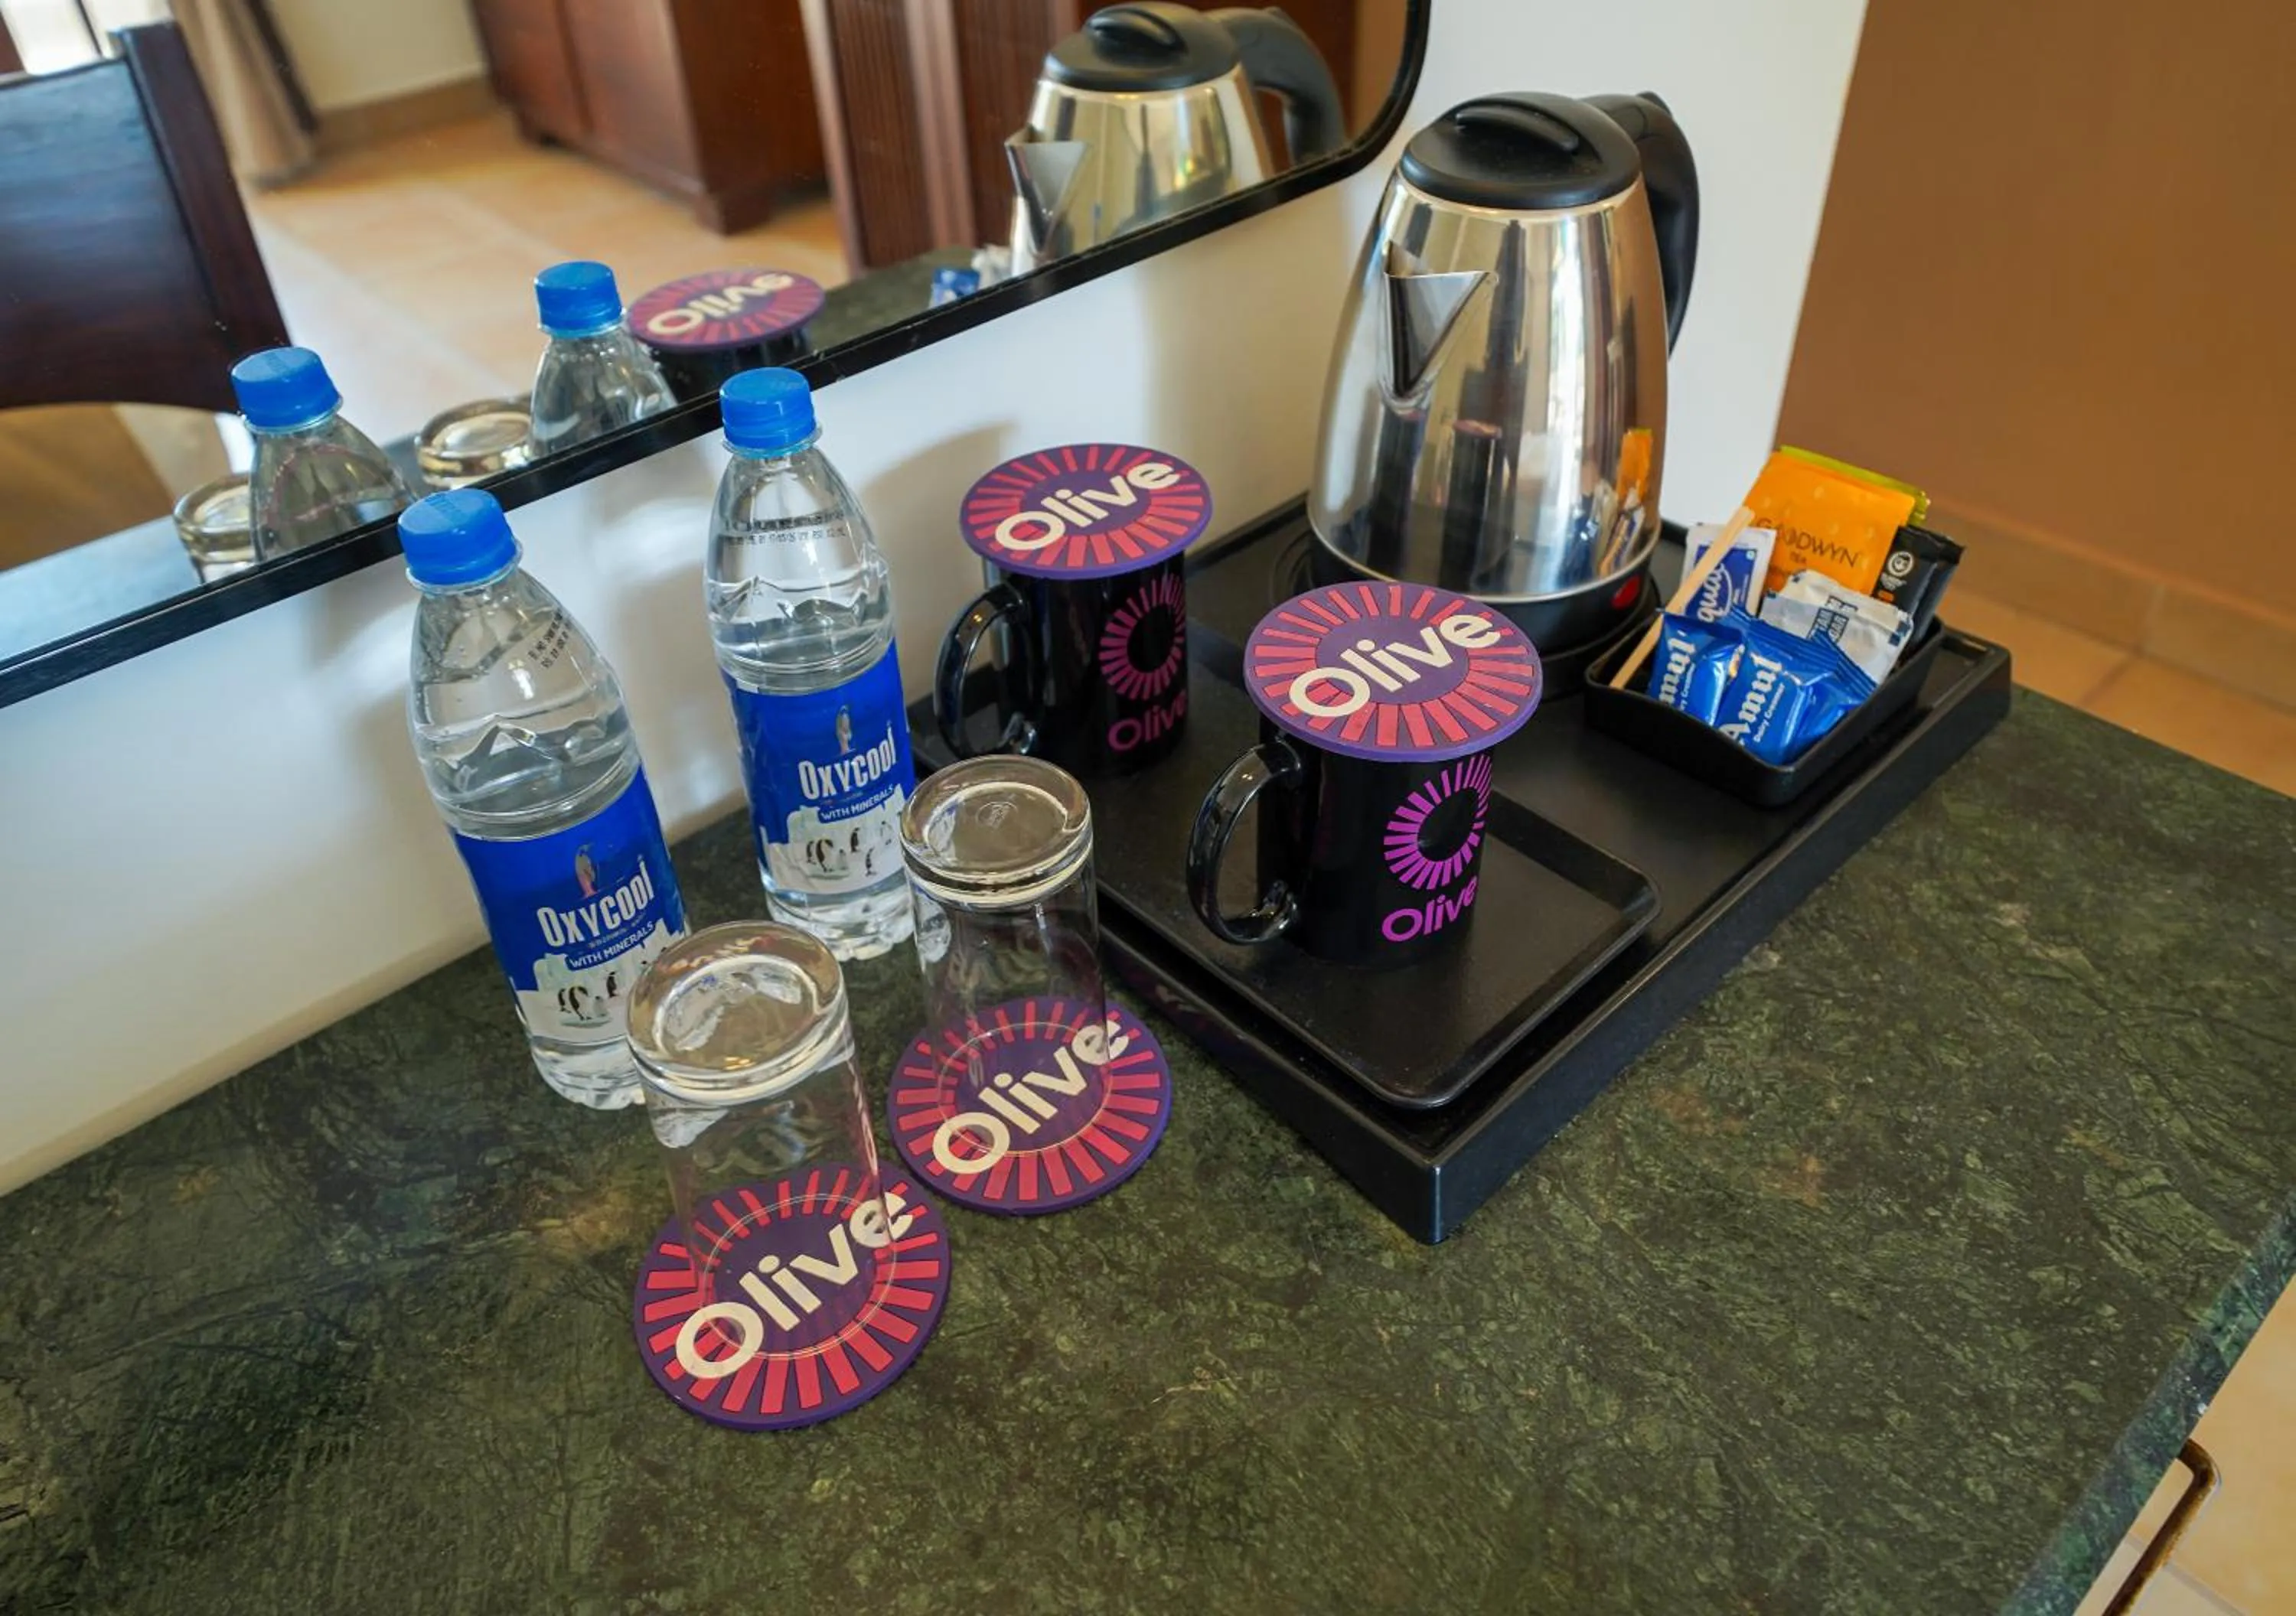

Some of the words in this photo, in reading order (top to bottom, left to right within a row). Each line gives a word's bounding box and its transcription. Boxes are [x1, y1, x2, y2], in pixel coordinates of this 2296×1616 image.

[993, 461, 1182, 550] Olive
[1288, 614, 1502, 717] Olive
[1658, 638, 1696, 705] mul
[1719, 652, 1782, 746] Amul
[1107, 689, 1187, 750] Olive
[820, 807, 850, 820] WITH
[850, 784, 894, 814] MINERALS
[569, 953, 603, 968] WITH
[603, 920, 654, 959] MINERALS
[1382, 875, 1477, 942] Olive
[933, 1018, 1130, 1175] Olive
[676, 1191, 913, 1379] Olive
